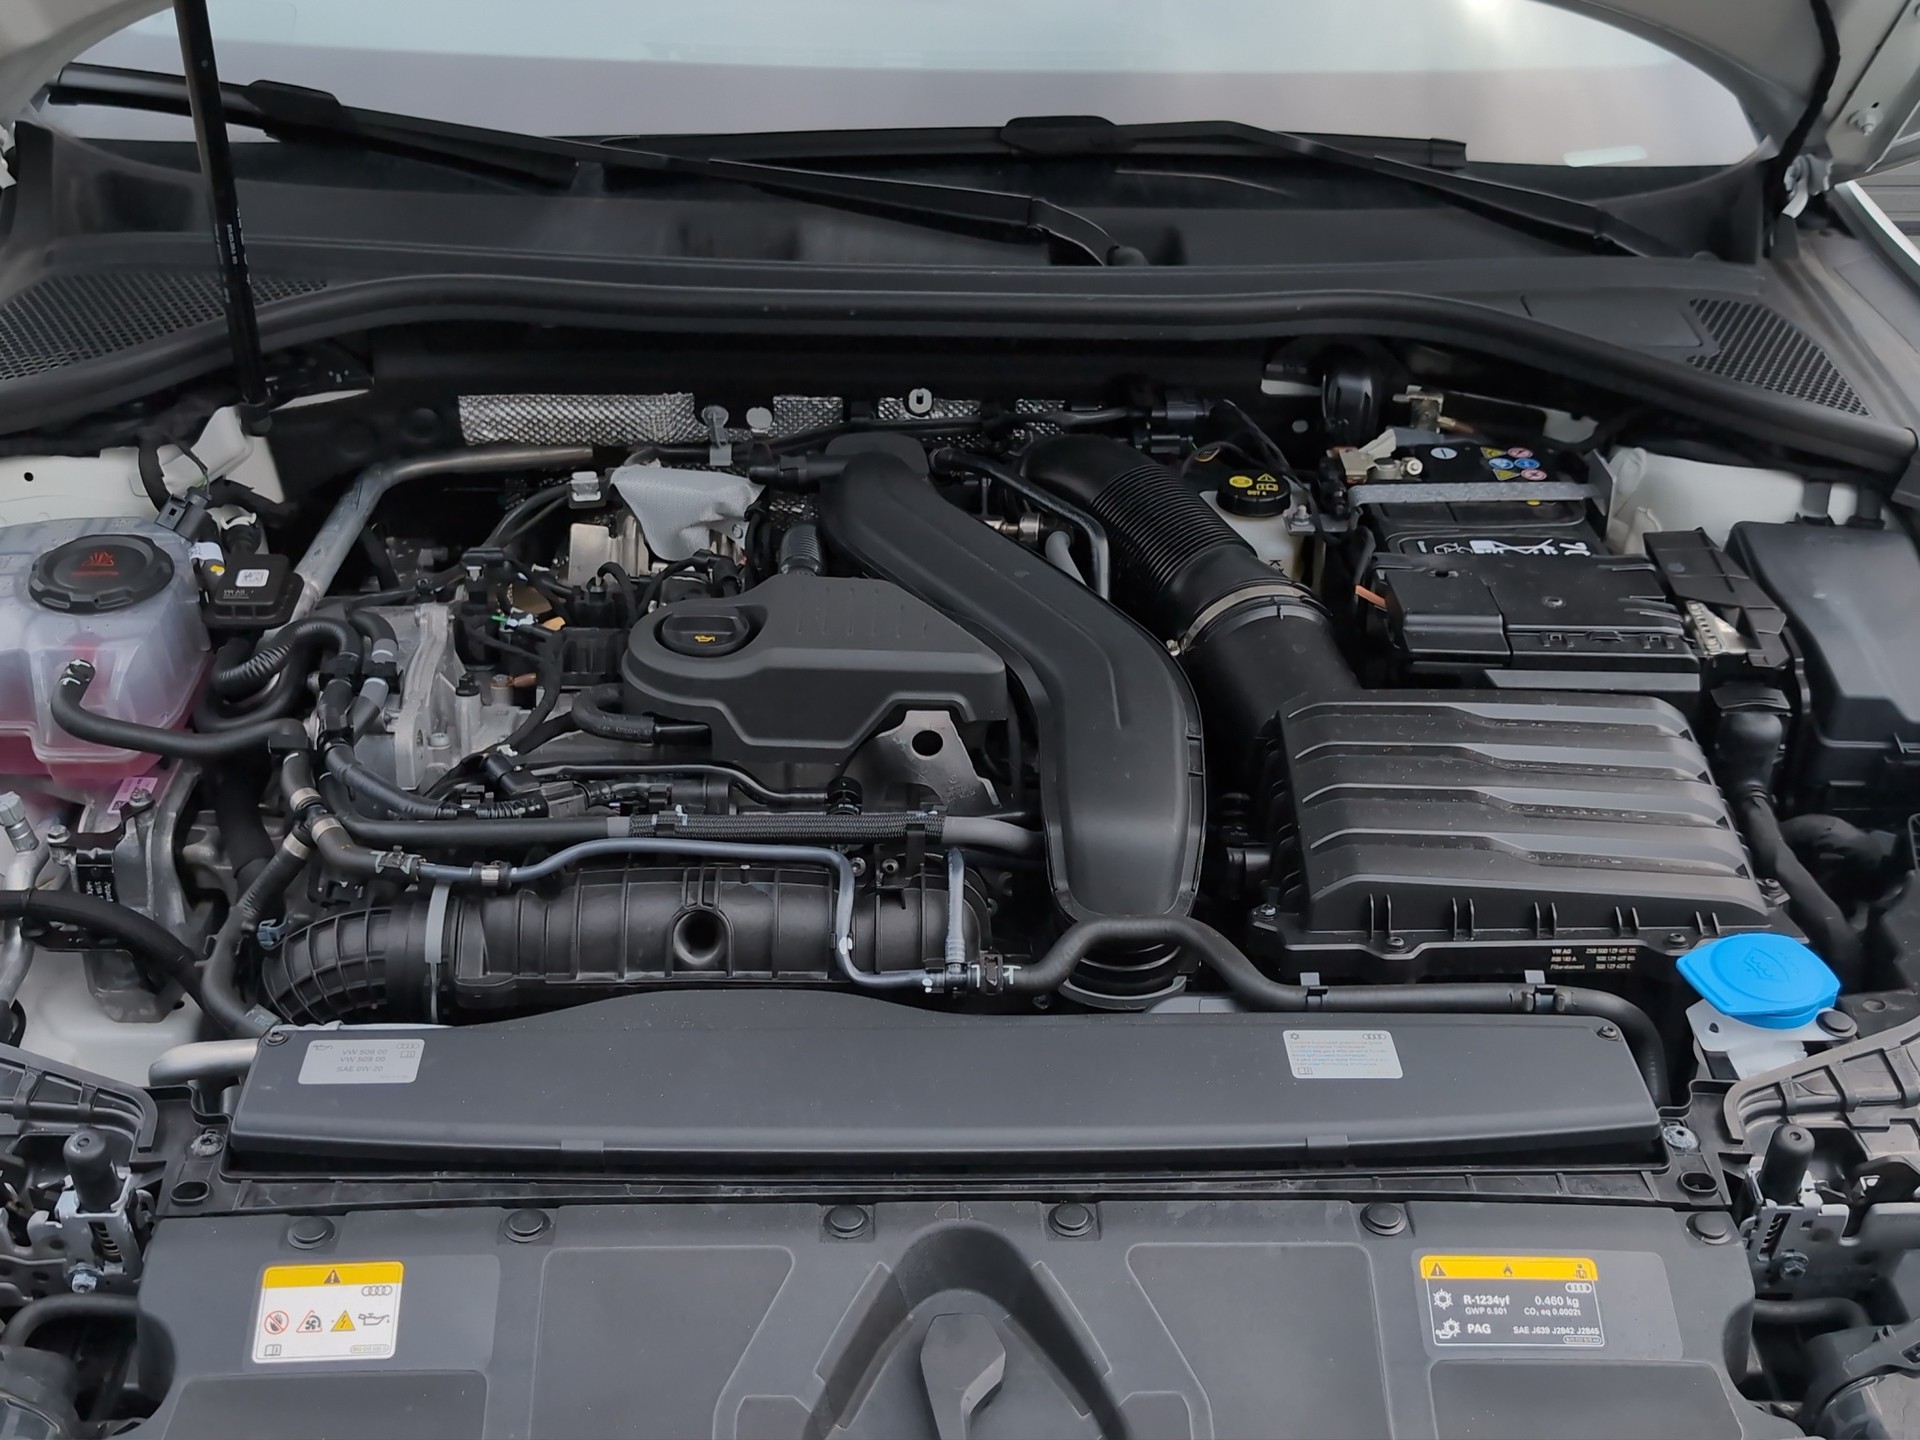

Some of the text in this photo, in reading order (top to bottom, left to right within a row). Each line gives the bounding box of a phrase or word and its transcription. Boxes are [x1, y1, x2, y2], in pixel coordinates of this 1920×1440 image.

[1534, 1295, 1580, 1308] 0.460 kg
[1465, 1307, 1485, 1315] GWP
[1467, 1323, 1492, 1334] PAG
[1513, 1326, 1530, 1334] SAE
[1531, 1326, 1551, 1335] J639
